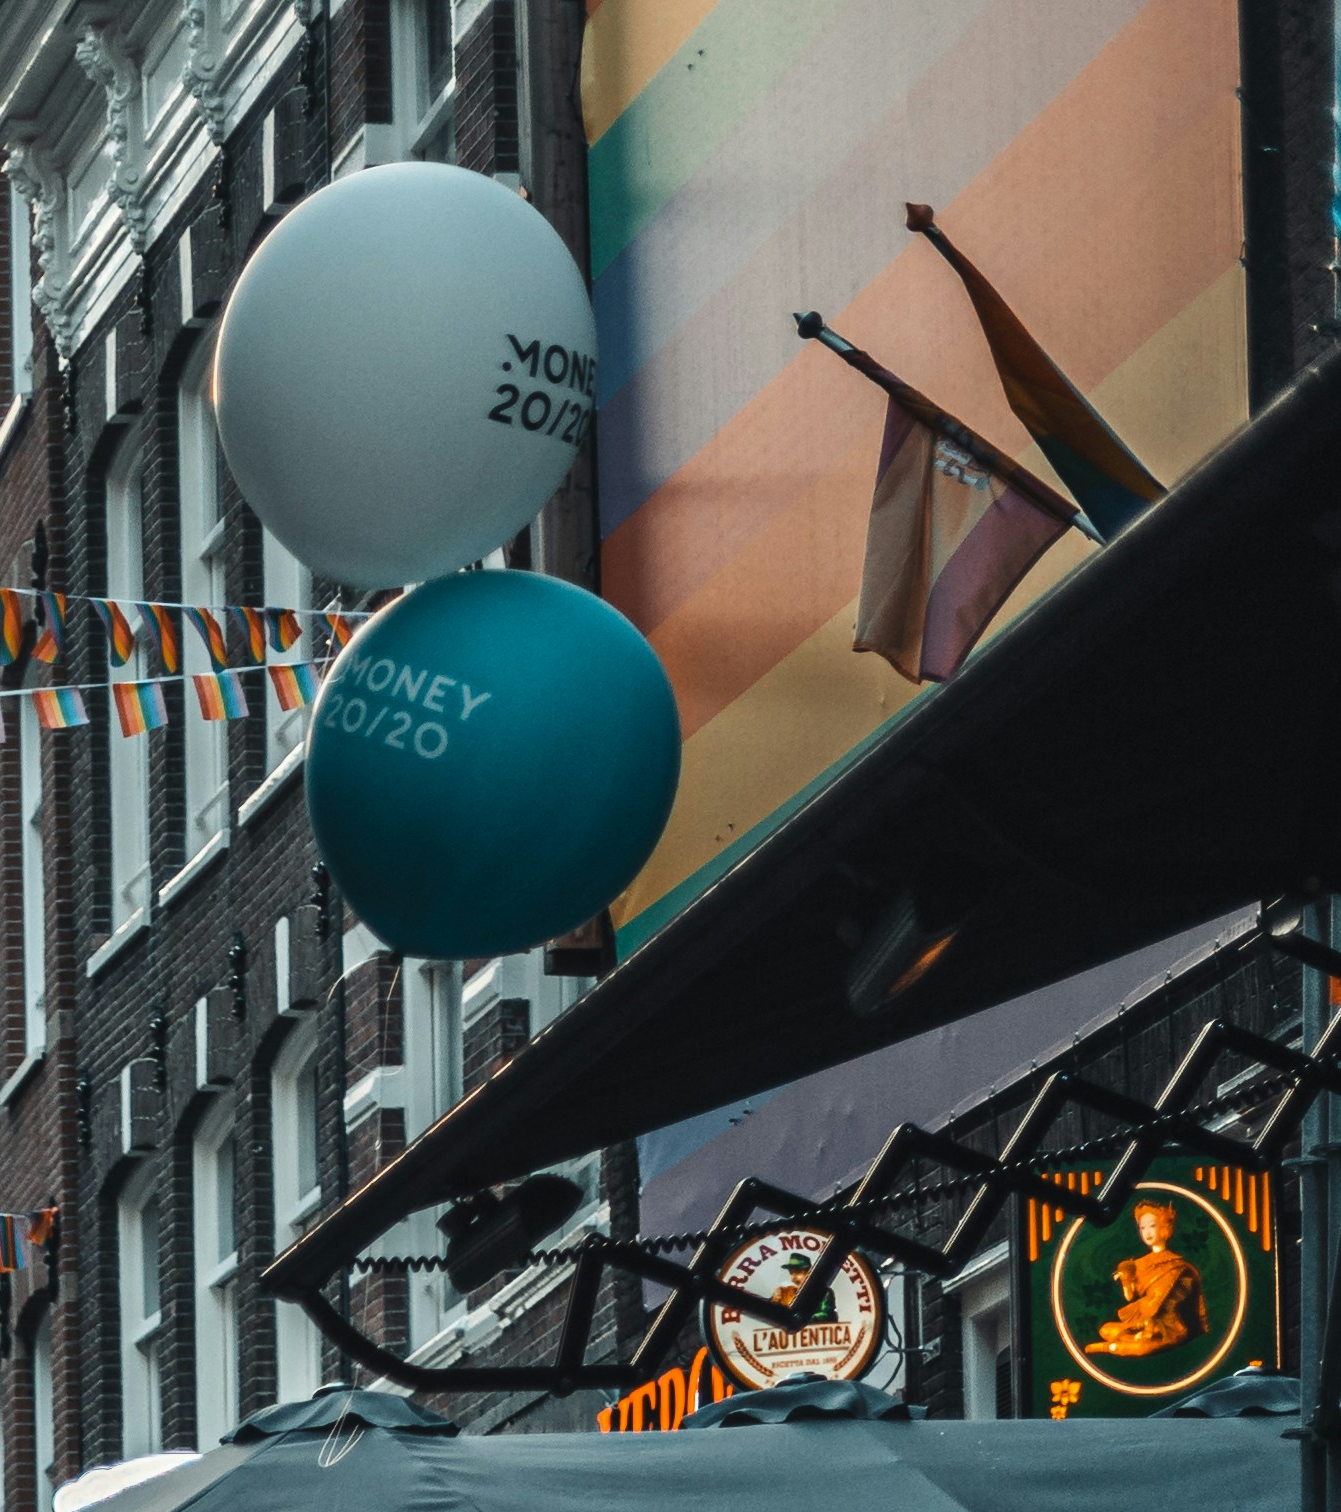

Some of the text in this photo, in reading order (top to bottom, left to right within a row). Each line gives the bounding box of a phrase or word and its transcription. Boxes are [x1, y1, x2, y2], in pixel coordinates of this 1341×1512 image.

[502, 333, 596, 398] MONE
[334, 654, 492, 722] MONEY
[324, 693, 449, 760] 20/20
[721, 1234, 872, 1325] BRRA MOETTI
